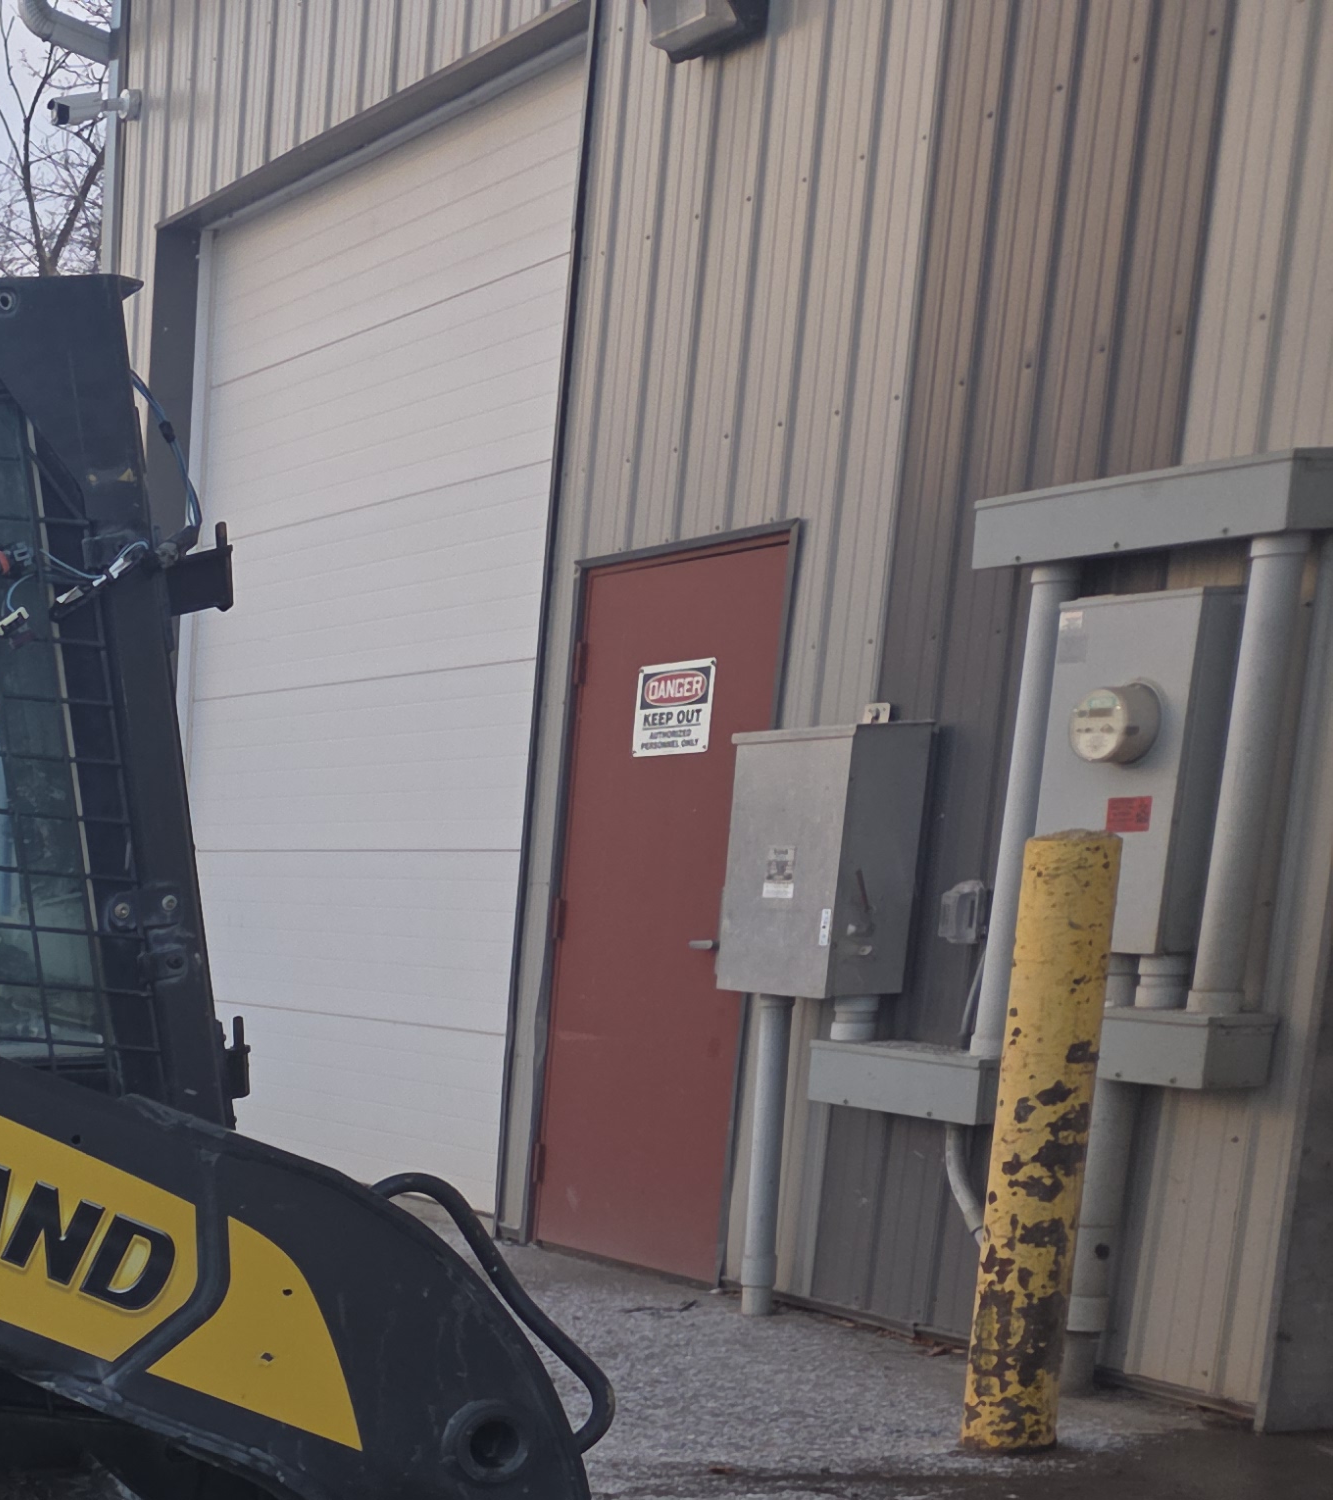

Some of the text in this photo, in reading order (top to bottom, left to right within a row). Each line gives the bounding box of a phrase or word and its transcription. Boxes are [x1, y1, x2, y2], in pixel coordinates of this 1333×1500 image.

[648, 676, 703, 700] DANGER
[643, 709, 703, 727] KEEP OUT
[650, 729, 692, 739] AUTHORIZED
[681, 738, 699, 747] ONLY
